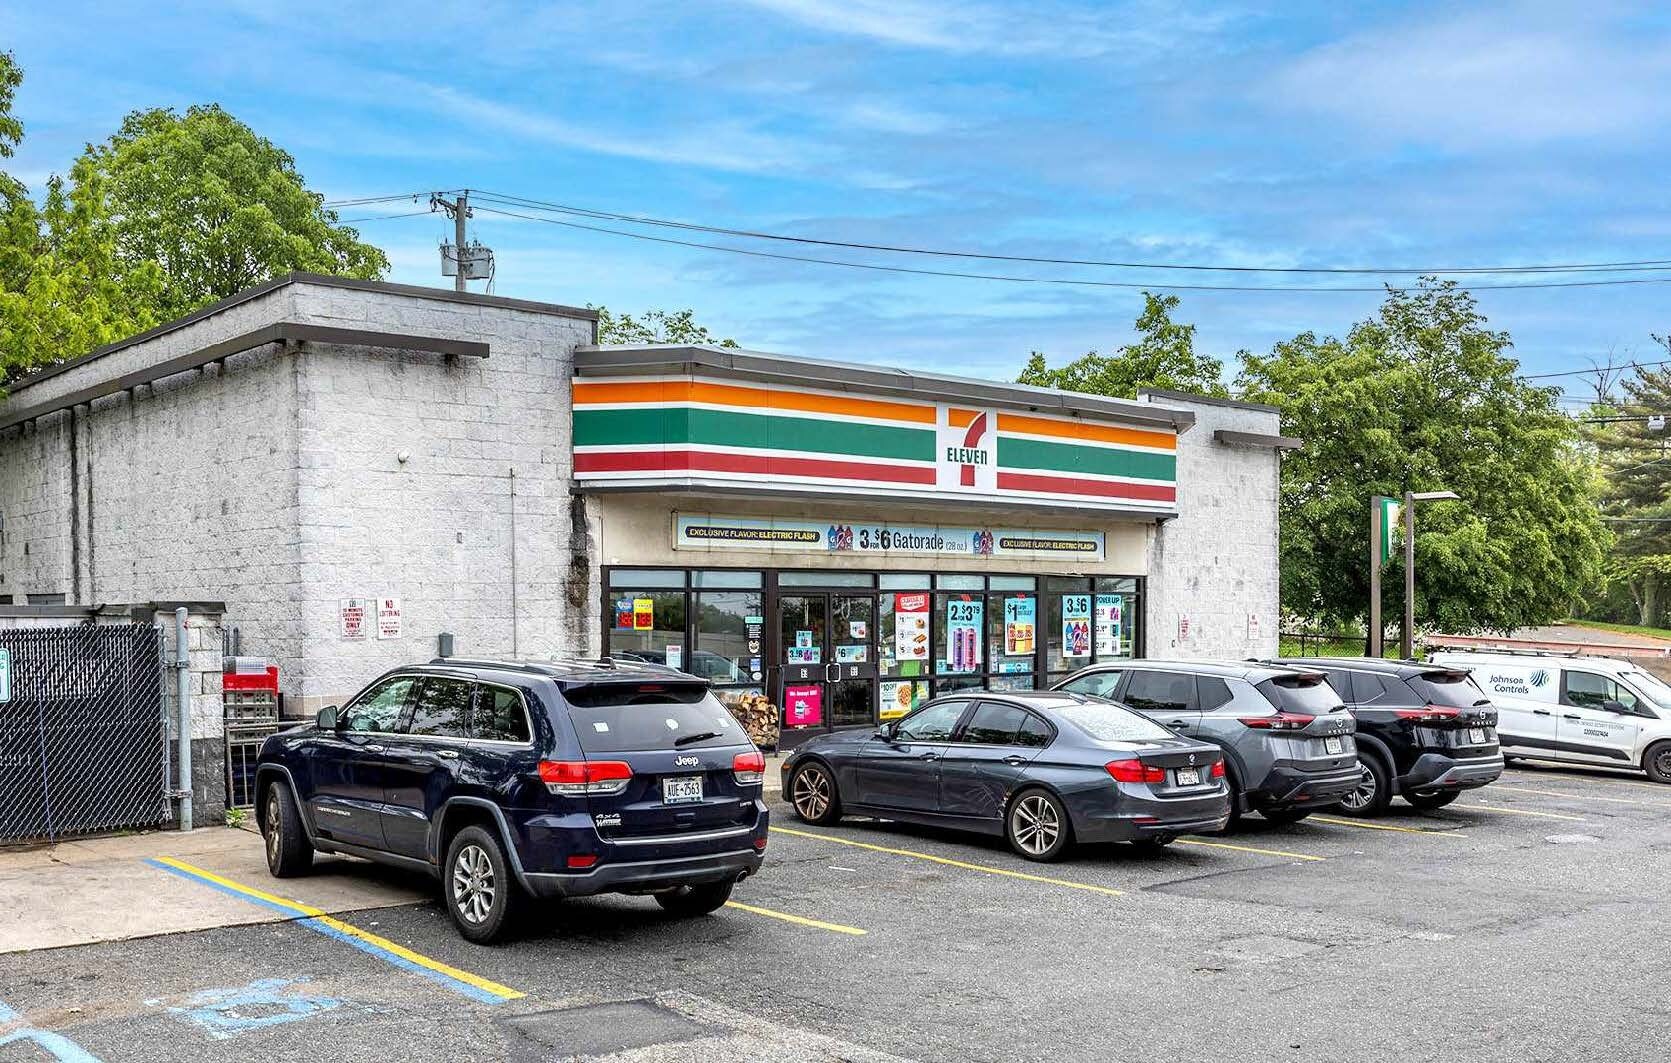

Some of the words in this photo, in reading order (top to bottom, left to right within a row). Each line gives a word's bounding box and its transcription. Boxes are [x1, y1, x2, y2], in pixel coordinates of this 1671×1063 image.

[960, 411, 987, 487] 7
[689, 528, 729, 537] EXCLUSIVE
[758, 531, 793, 540] ELECTRIC
[794, 533, 817, 541] FLASH
[860, 529, 870, 549] 3
[875, 528, 891, 550] $6
[893, 531, 944, 550] Gatorade
[1003, 539, 1032, 548] EXCLUSIVE
[1052, 541, 1077, 550] ELECTRIC
[1077, 542, 1095, 550] FLASH
[1007, 603, 1017, 621] $1
[1066, 598, 1074, 613] 3
[1077, 597, 1087, 613] $6
[950, 605, 958, 621] 2
[1489, 674, 1524, 685] Johnson
[1494, 683, 1529, 694] Controls
[675, 755, 699, 767] Jeep
